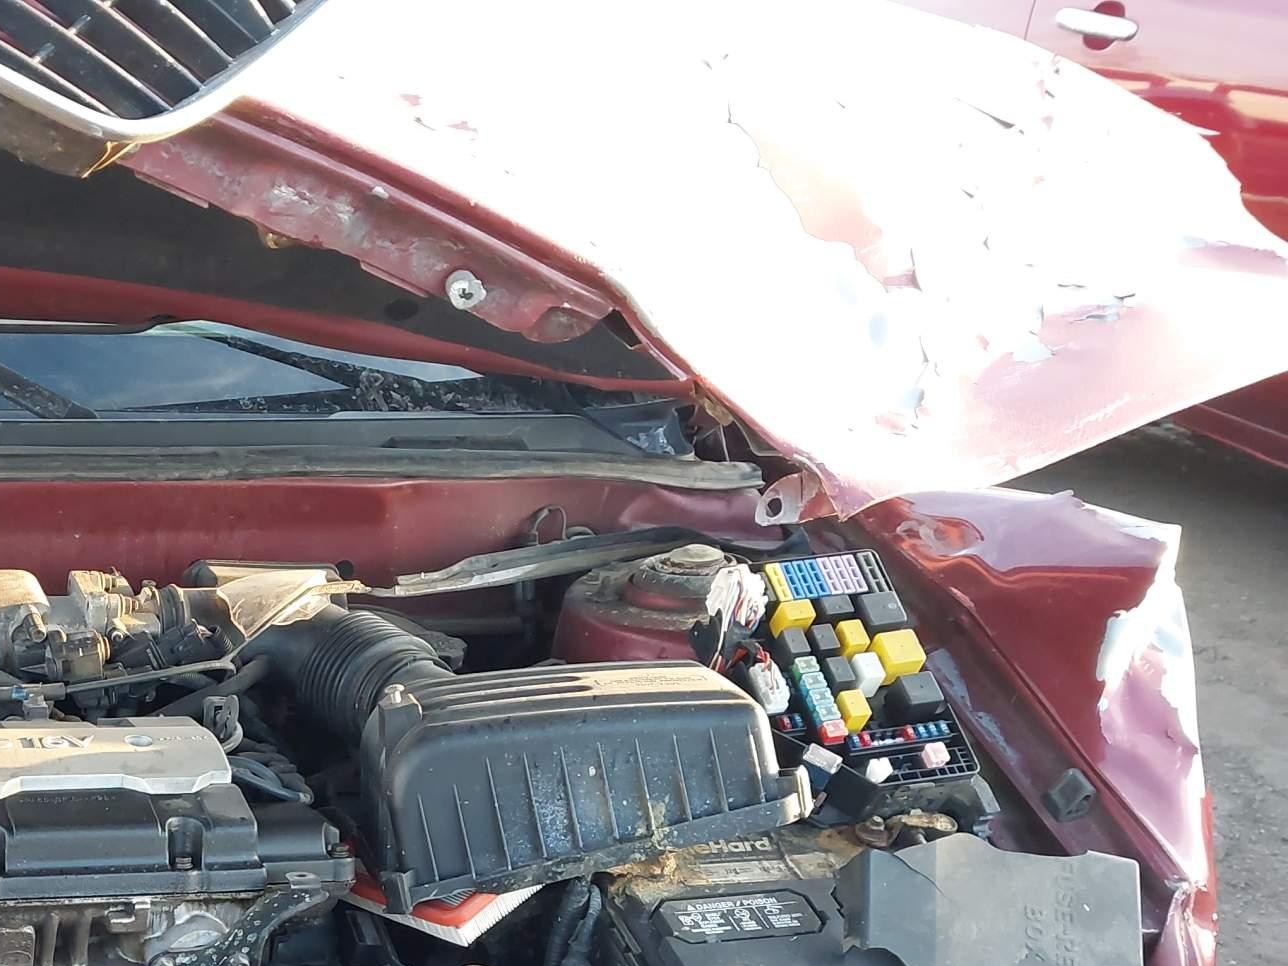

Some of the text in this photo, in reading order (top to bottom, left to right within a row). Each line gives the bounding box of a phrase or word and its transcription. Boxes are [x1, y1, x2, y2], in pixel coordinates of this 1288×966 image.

[19, 735, 96, 750] 16V
[696, 901, 734, 911] DANGER
[743, 896, 777, 906] POISON
[1024, 903, 1046, 962] BOX
